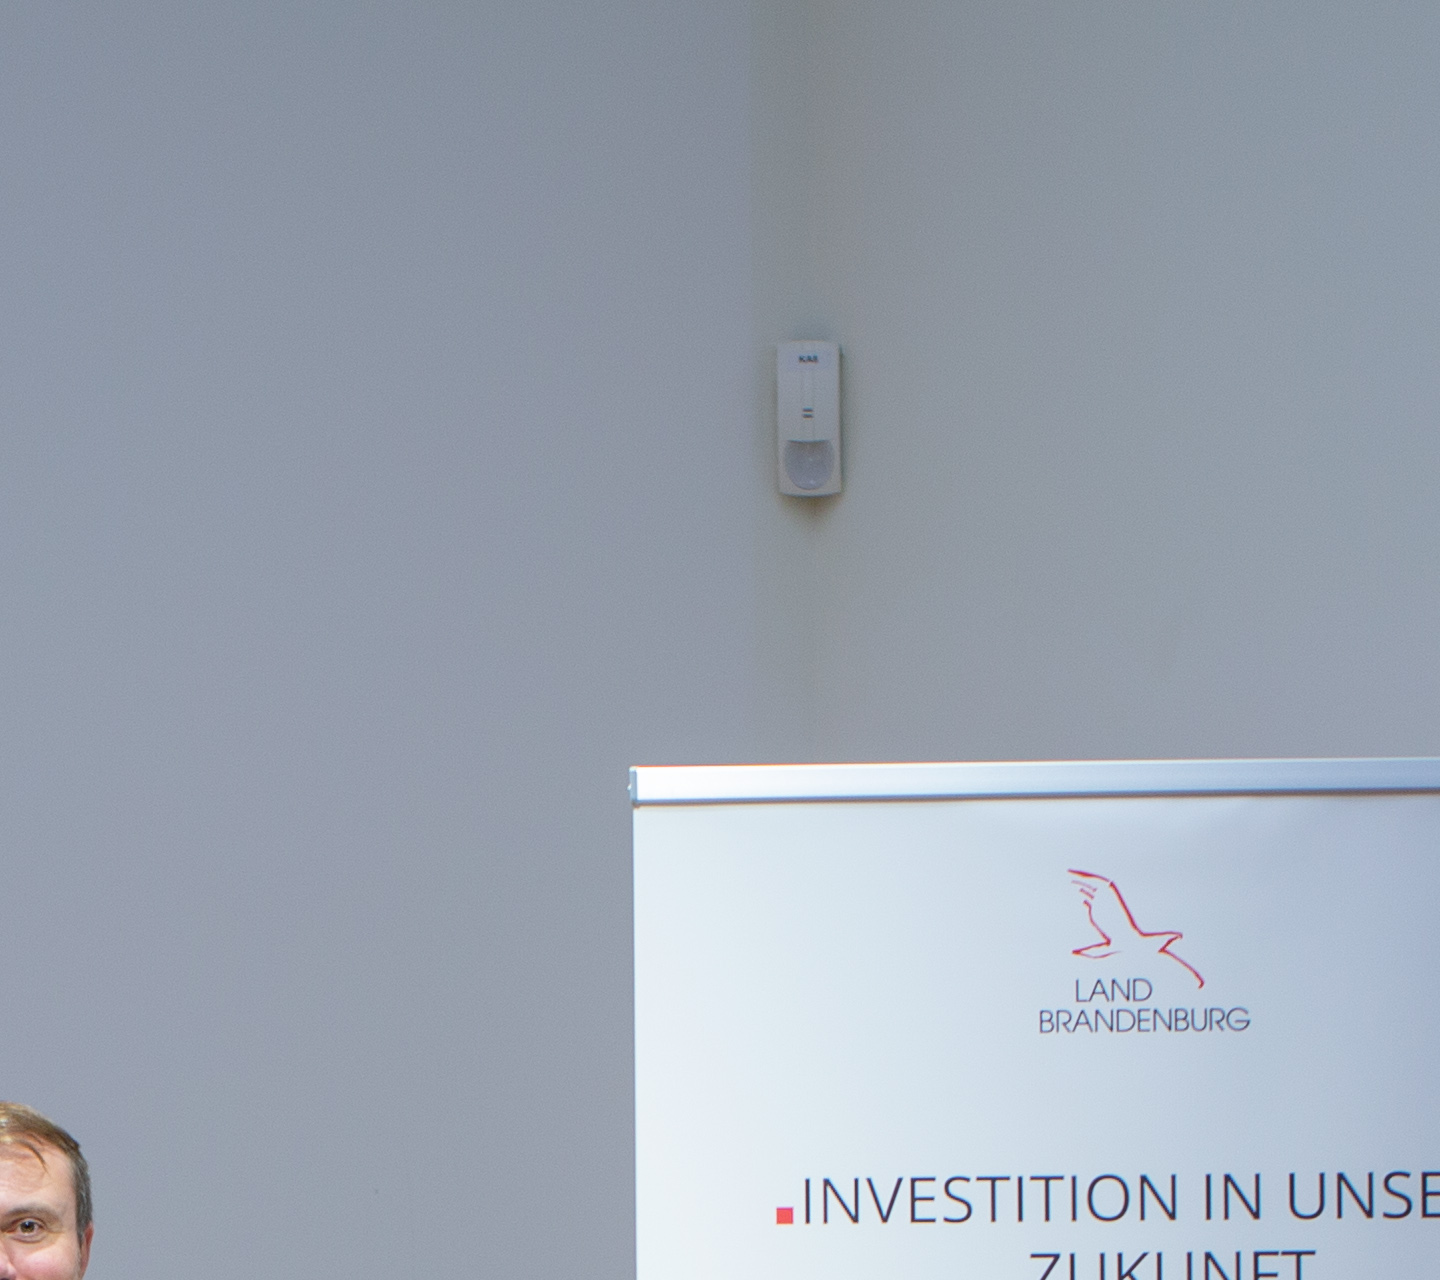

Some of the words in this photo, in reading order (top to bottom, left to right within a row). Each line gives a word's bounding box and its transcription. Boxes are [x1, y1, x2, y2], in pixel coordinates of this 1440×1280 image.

[1075, 978, 1154, 1002] LAND
[1039, 1007, 1252, 1034] BRANDENBURG
[804, 1173, 1178, 1224] INVESTITION
[1205, 1172, 1262, 1220] IN
